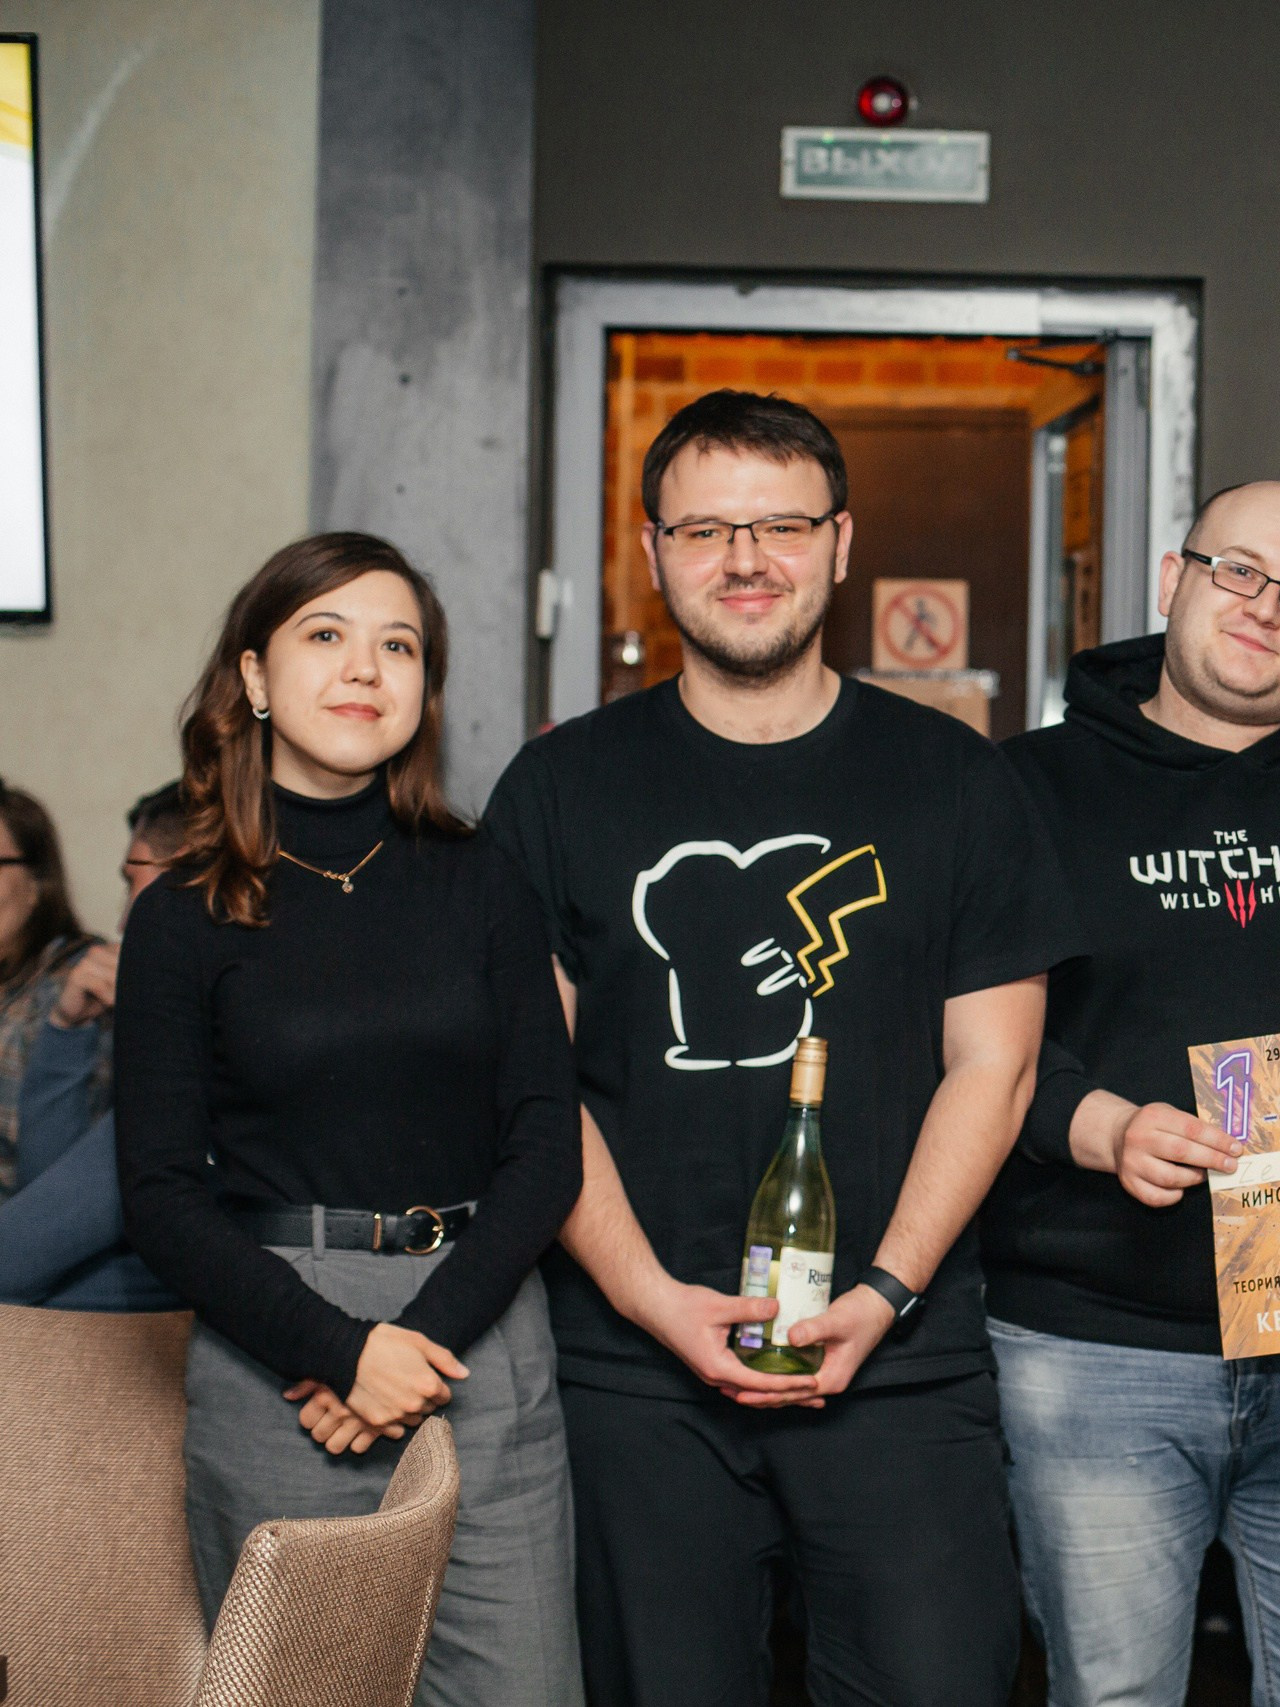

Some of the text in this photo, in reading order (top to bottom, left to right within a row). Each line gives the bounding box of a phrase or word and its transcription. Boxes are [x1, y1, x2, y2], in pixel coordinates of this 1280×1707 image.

[1213, 829, 1248, 845] THE
[1160, 888, 1221, 910] WILD
[1265, 1047, 1280, 1062] 29
[1233, 1275, 1280, 1294] ТЕОРИЯ
